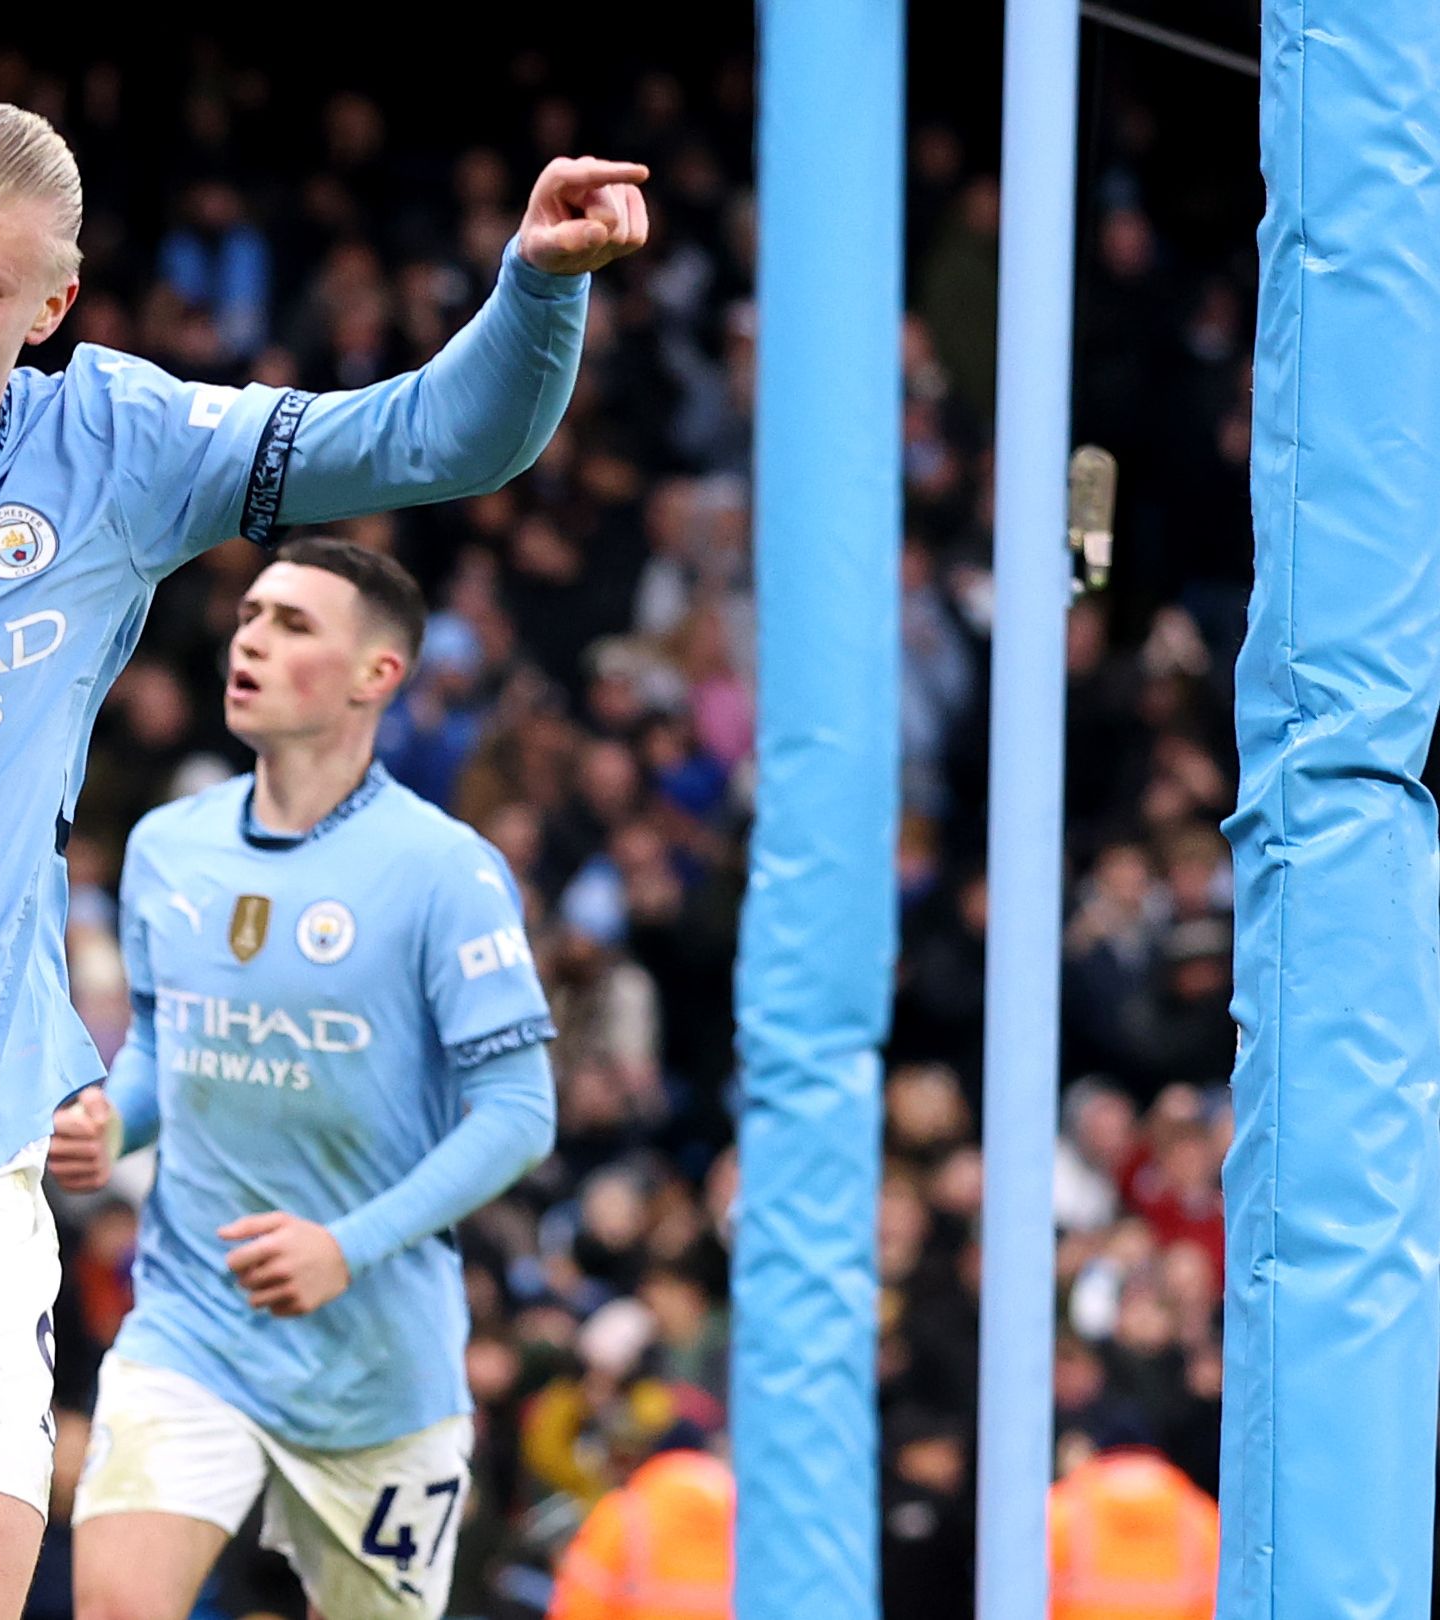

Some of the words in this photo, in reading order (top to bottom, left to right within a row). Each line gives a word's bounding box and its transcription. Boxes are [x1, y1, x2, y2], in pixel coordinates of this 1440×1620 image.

[15, 565, 38, 577] CITY
[172, 1047, 311, 1091] AIRWAYS
[362, 1477, 460, 1571] 47
